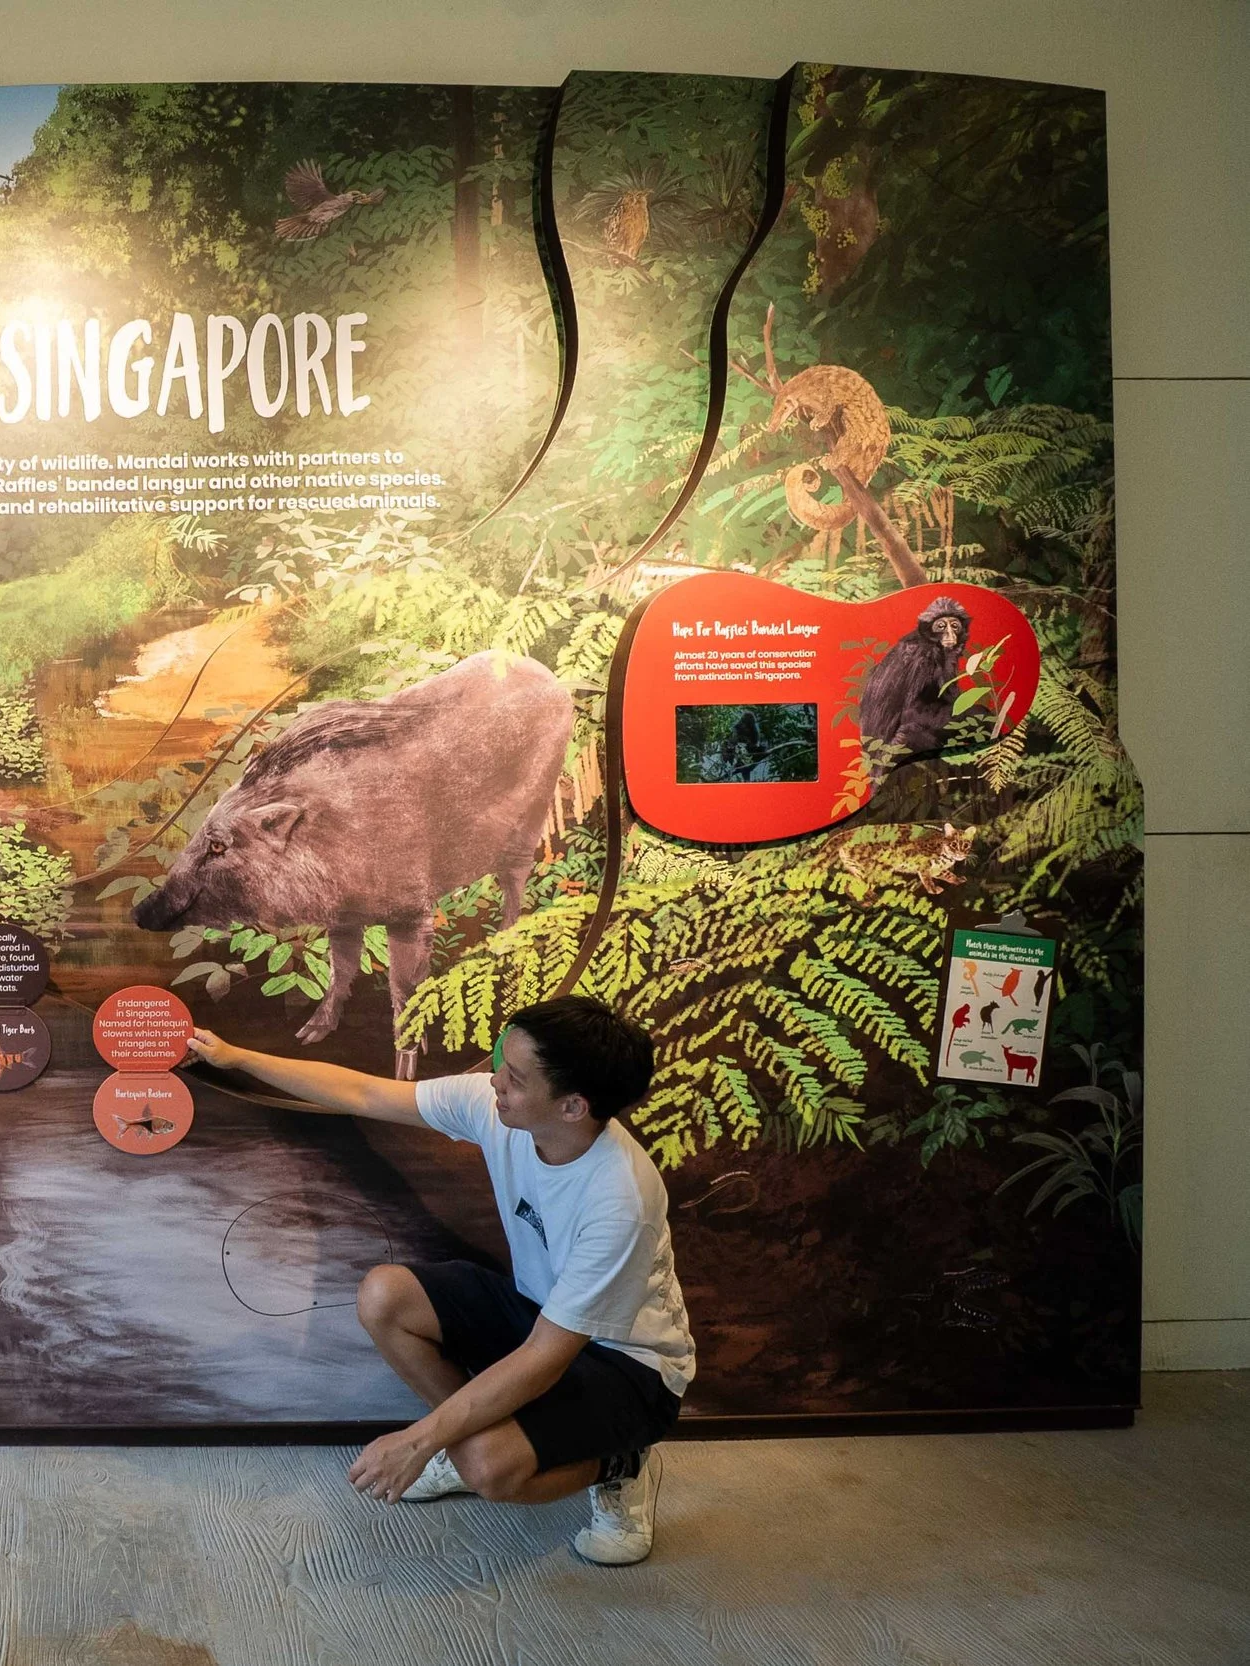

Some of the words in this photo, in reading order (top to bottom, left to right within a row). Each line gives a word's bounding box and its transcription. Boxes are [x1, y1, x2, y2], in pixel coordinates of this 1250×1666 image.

[19, 456, 39, 471] of
[41, 455, 114, 470] wildlife.
[117, 453, 188, 469] Mandai
[192, 453, 249, 467] works
[253, 451, 294, 466] with
[299, 452, 381, 469] partners
[384, 450, 406, 464] to
[66, 476, 138, 491] banded
[143, 476, 206, 494] langur
[209, 474, 246, 489] and
[250, 474, 302, 488] other
[306, 471, 366, 486] native
[370, 470, 446, 490] species.
[38, 498, 166, 513] rehabilitative
[170, 497, 244, 515] support
[248, 496, 275, 510] for
[279, 495, 356, 510] rescued
[358, 493, 440, 508] animals.
[672, 622, 694, 638] Hope
[695, 621, 712, 636] For
[714, 621, 748, 639] Raffles'
[751, 620, 785, 635] Banded
[787, 620, 820, 637] Langur
[707, 651, 719, 659] 20
[720, 652, 745, 661] years
[746, 650, 756, 658] of
[757, 650, 816, 658] conservation
[674, 662, 704, 670] efforts
[705, 662, 729, 670] have
[759, 661, 776, 669] this
[777, 661, 811, 670] species
[674, 673, 697, 681] from
[698, 672, 743, 680] extinction
[754, 672, 801, 681] Singapore.
[117, 1000, 170, 1009] Endangered
[125, 1010, 171, 1019] Singapore.
[147, 1020, 188, 1028] harlequin
[2, 1024, 18, 1036] Tiger
[20, 1024, 35, 1034] Barb
[162, 1030, 185, 1039] sport
[118, 1040, 156, 1049] triangles
